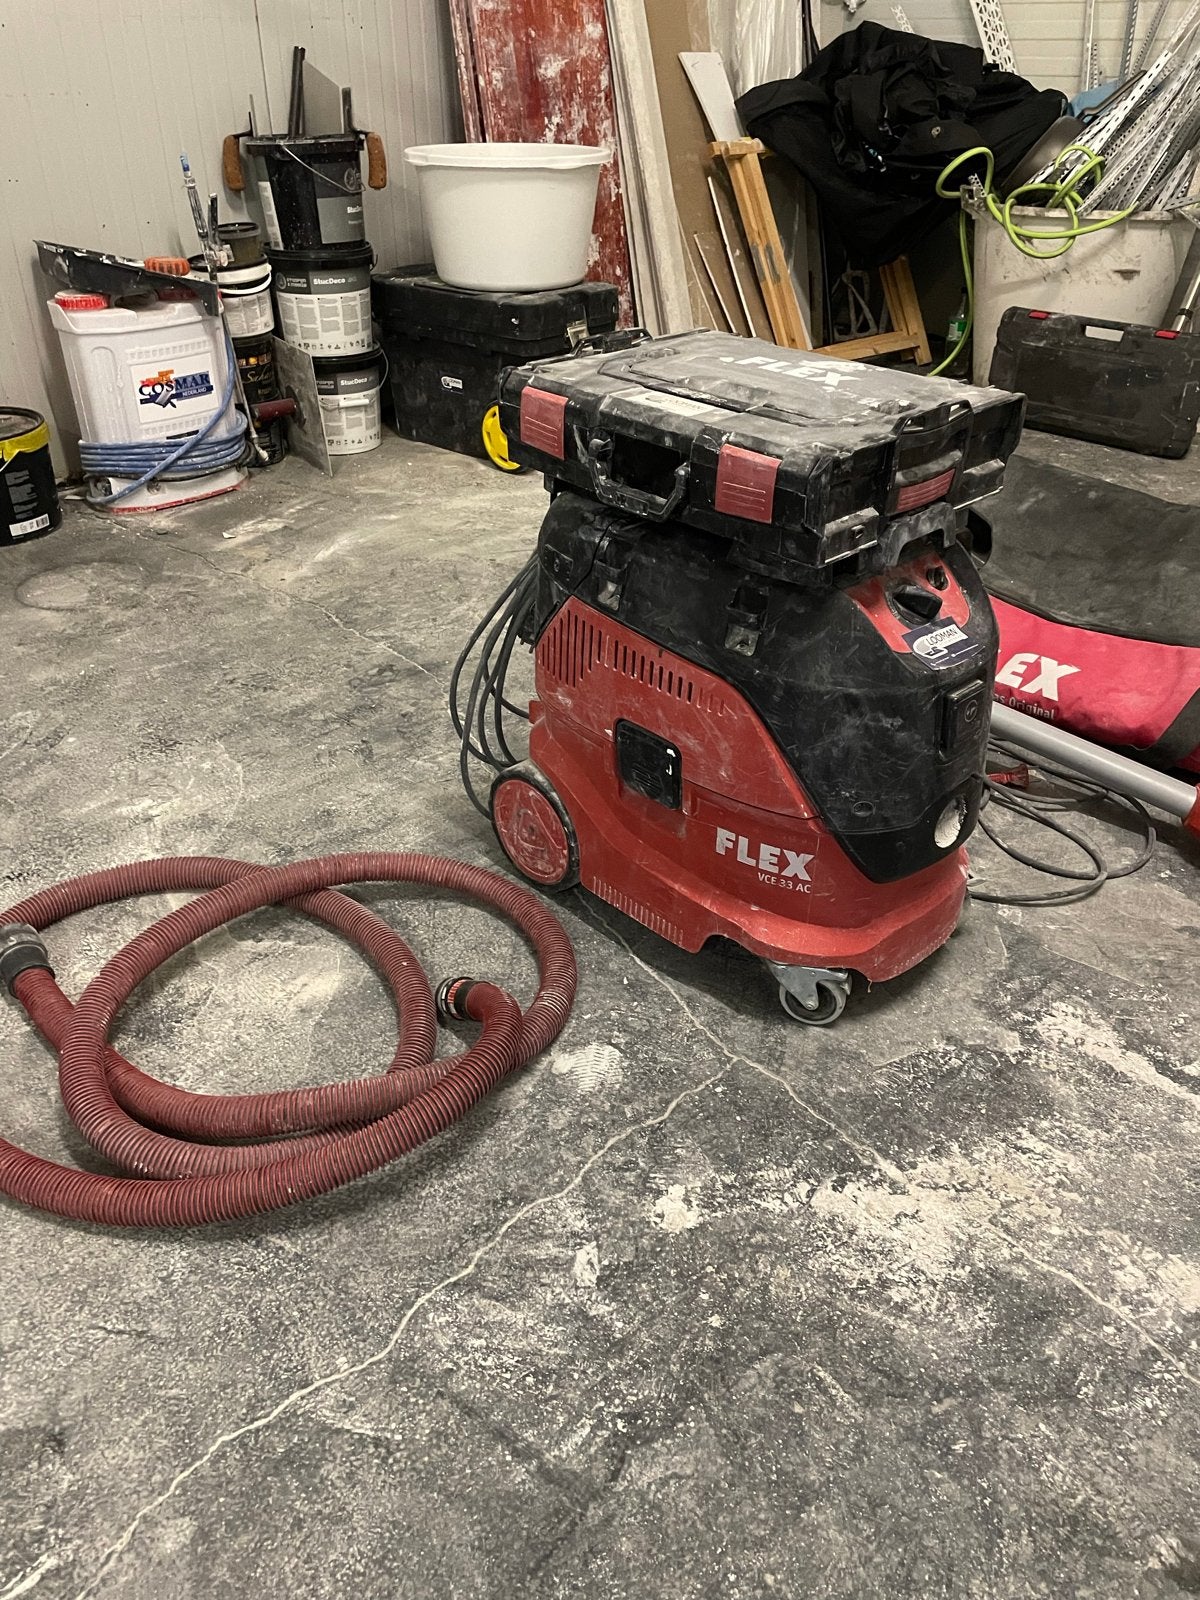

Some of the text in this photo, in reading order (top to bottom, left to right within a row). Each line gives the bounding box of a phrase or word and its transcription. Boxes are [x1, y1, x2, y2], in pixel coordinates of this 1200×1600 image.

[734, 356, 861, 387] FLEX
[138, 373, 211, 397] COSMAR
[182, 387, 207, 398] NEDERLAND
[926, 627, 958, 646] LOOMAN
[994, 652, 1082, 702] EX
[1008, 697, 1055, 720] Original
[716, 827, 815, 882] FLEX
[757, 872, 812, 894] VCE 33 AC
